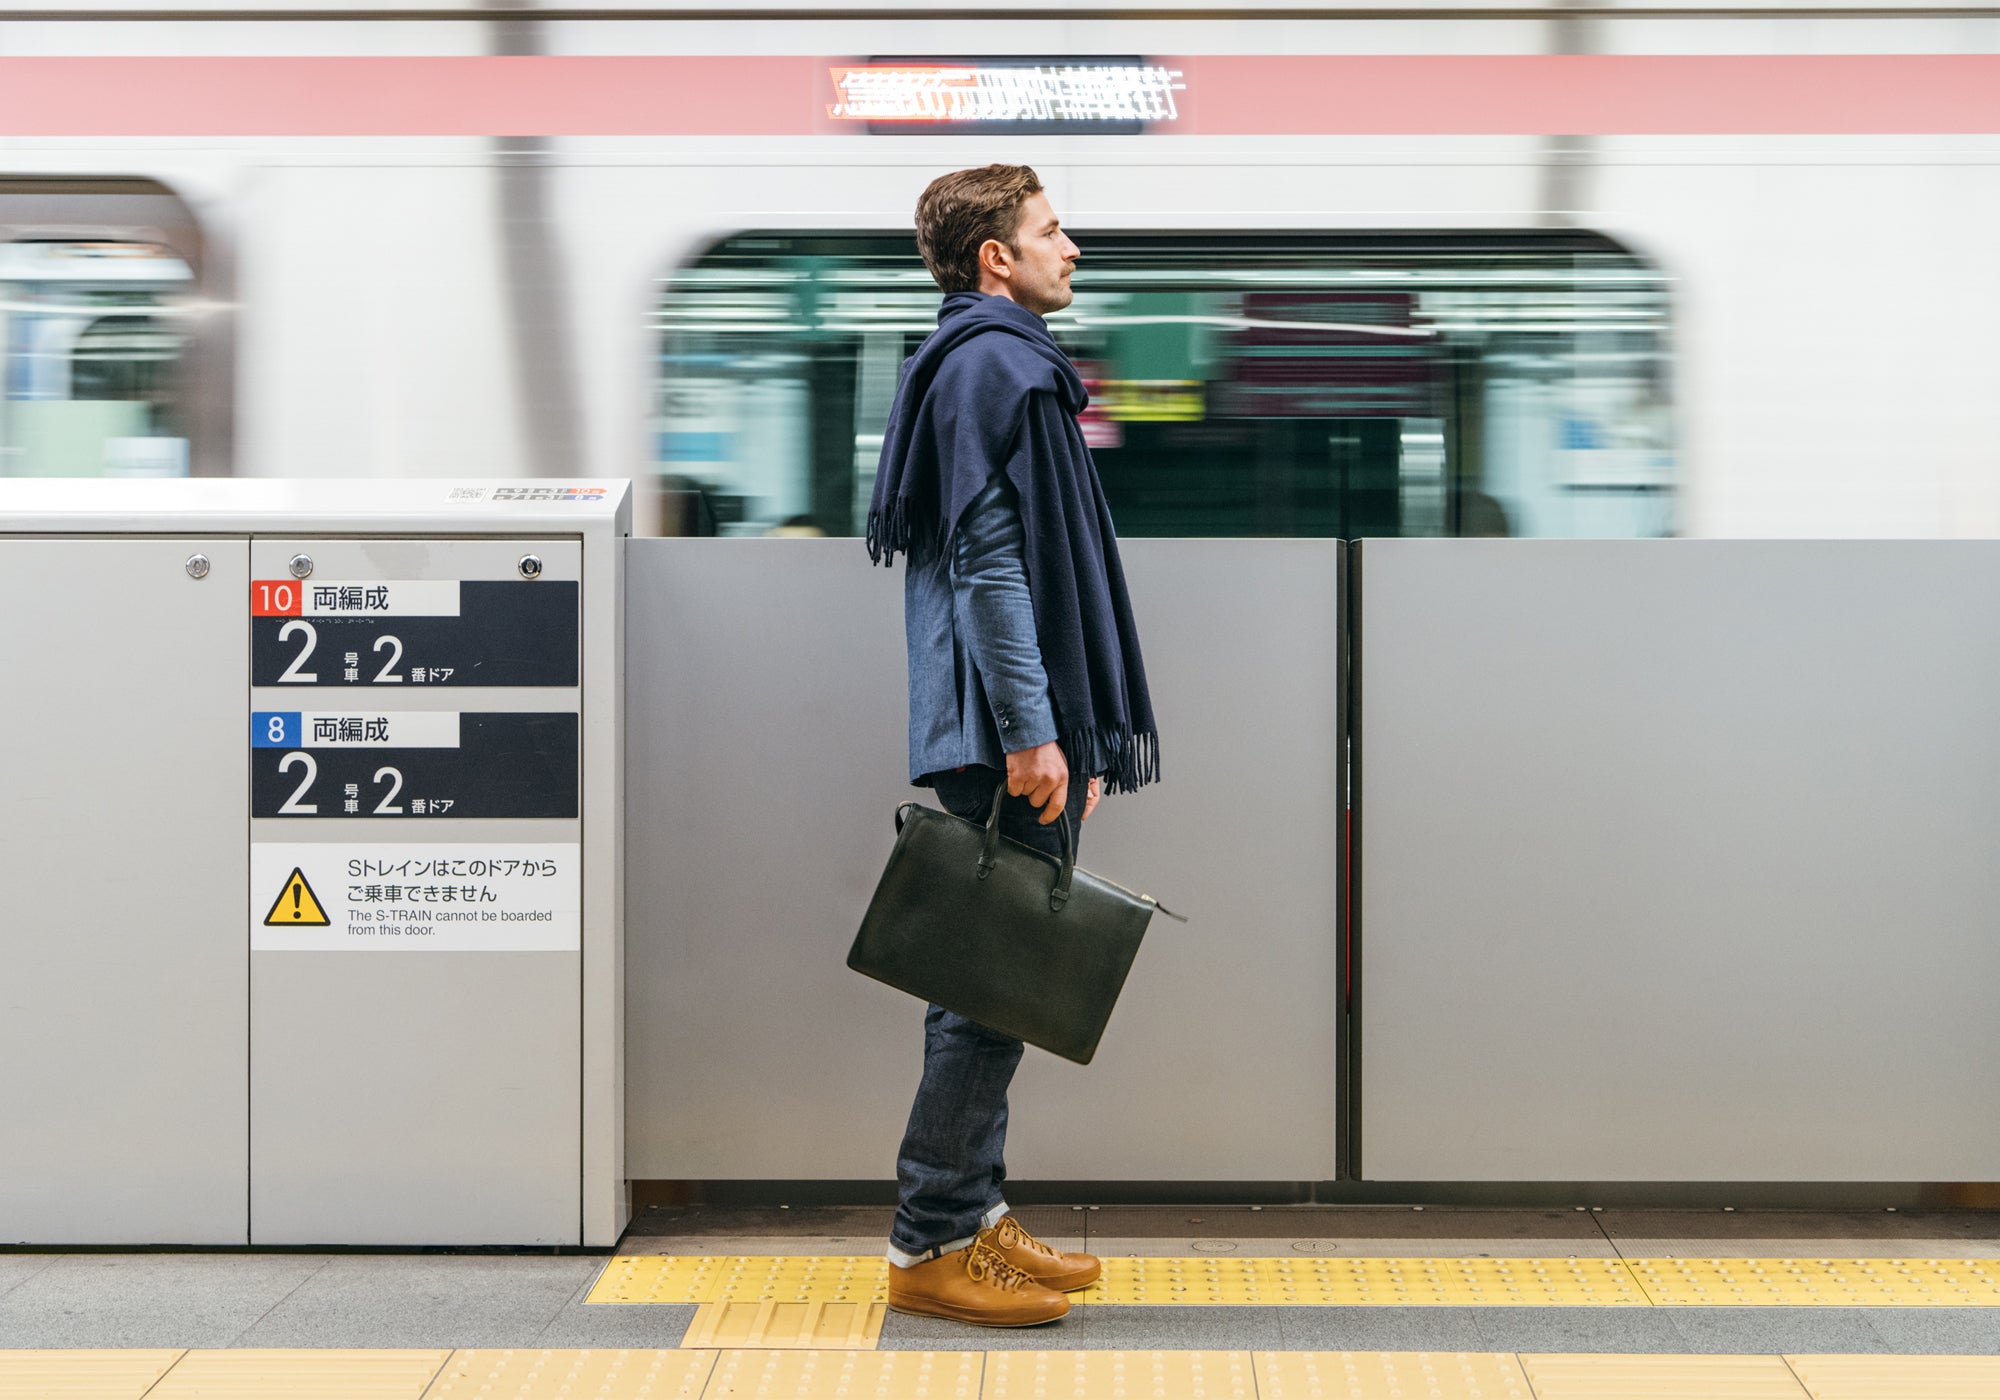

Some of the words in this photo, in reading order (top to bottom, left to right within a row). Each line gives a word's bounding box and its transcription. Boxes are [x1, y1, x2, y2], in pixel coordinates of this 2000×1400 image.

[261, 585, 292, 611] 10
[313, 586, 388, 610] 両編成
[278, 620, 318, 683] 2
[373, 635, 402, 682] 2
[412, 668, 454, 682] 番ドア
[268, 717, 284, 742] 8
[313, 717, 389, 742] 両編成
[278, 752, 317, 813] 2
[373, 767, 403, 813] 2
[412, 799, 454, 813] 番ドア
[348, 860, 556, 877] Sトレインはこのドアから
[348, 885, 497, 903] ご乗車できません
[348, 910, 372, 921] The
[376, 910, 431, 921] S-TRAIN
[436, 911, 477, 921] cannot
[482, 910, 497, 921] be
[501, 910, 552, 921] boarded
[348, 924, 375, 935] from
[379, 924, 401, 935] this
[405, 924, 435, 935] door.
